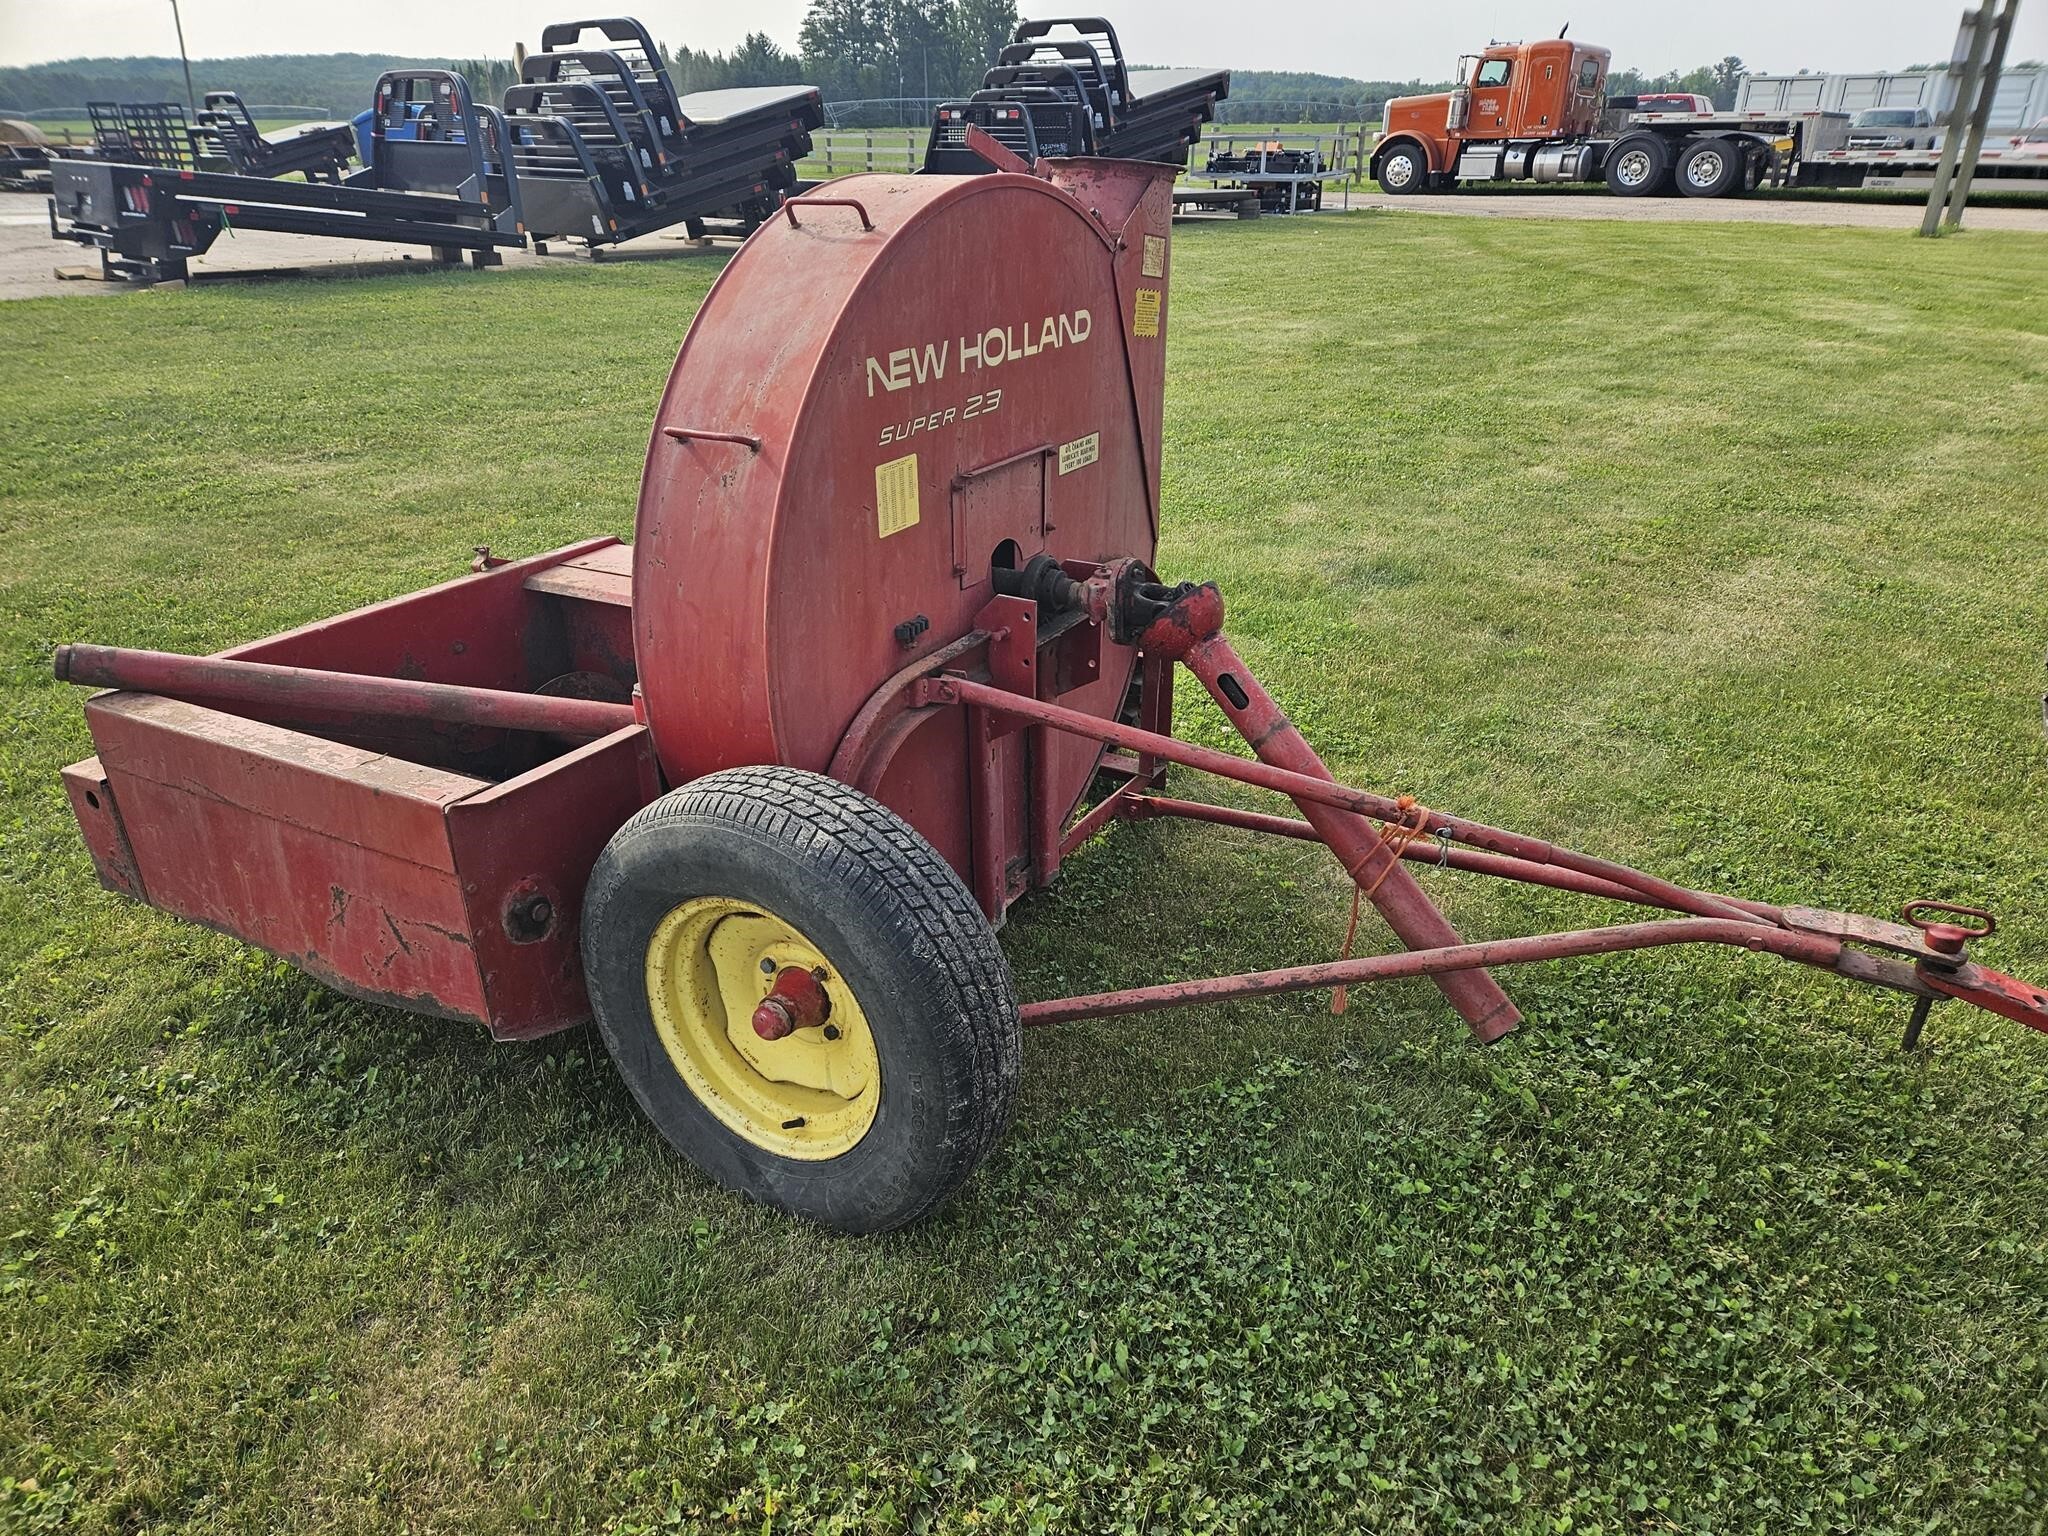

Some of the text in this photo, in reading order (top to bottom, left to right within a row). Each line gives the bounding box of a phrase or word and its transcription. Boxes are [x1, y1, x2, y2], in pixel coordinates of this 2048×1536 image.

[865, 340, 949, 398] NEW
[960, 309, 1092, 374] HOLLAND
[878, 388, 1003, 447] SUPER 23
[1072, 440, 1085, 451] CHAINS
[1064, 461, 1075, 471] EVERY
